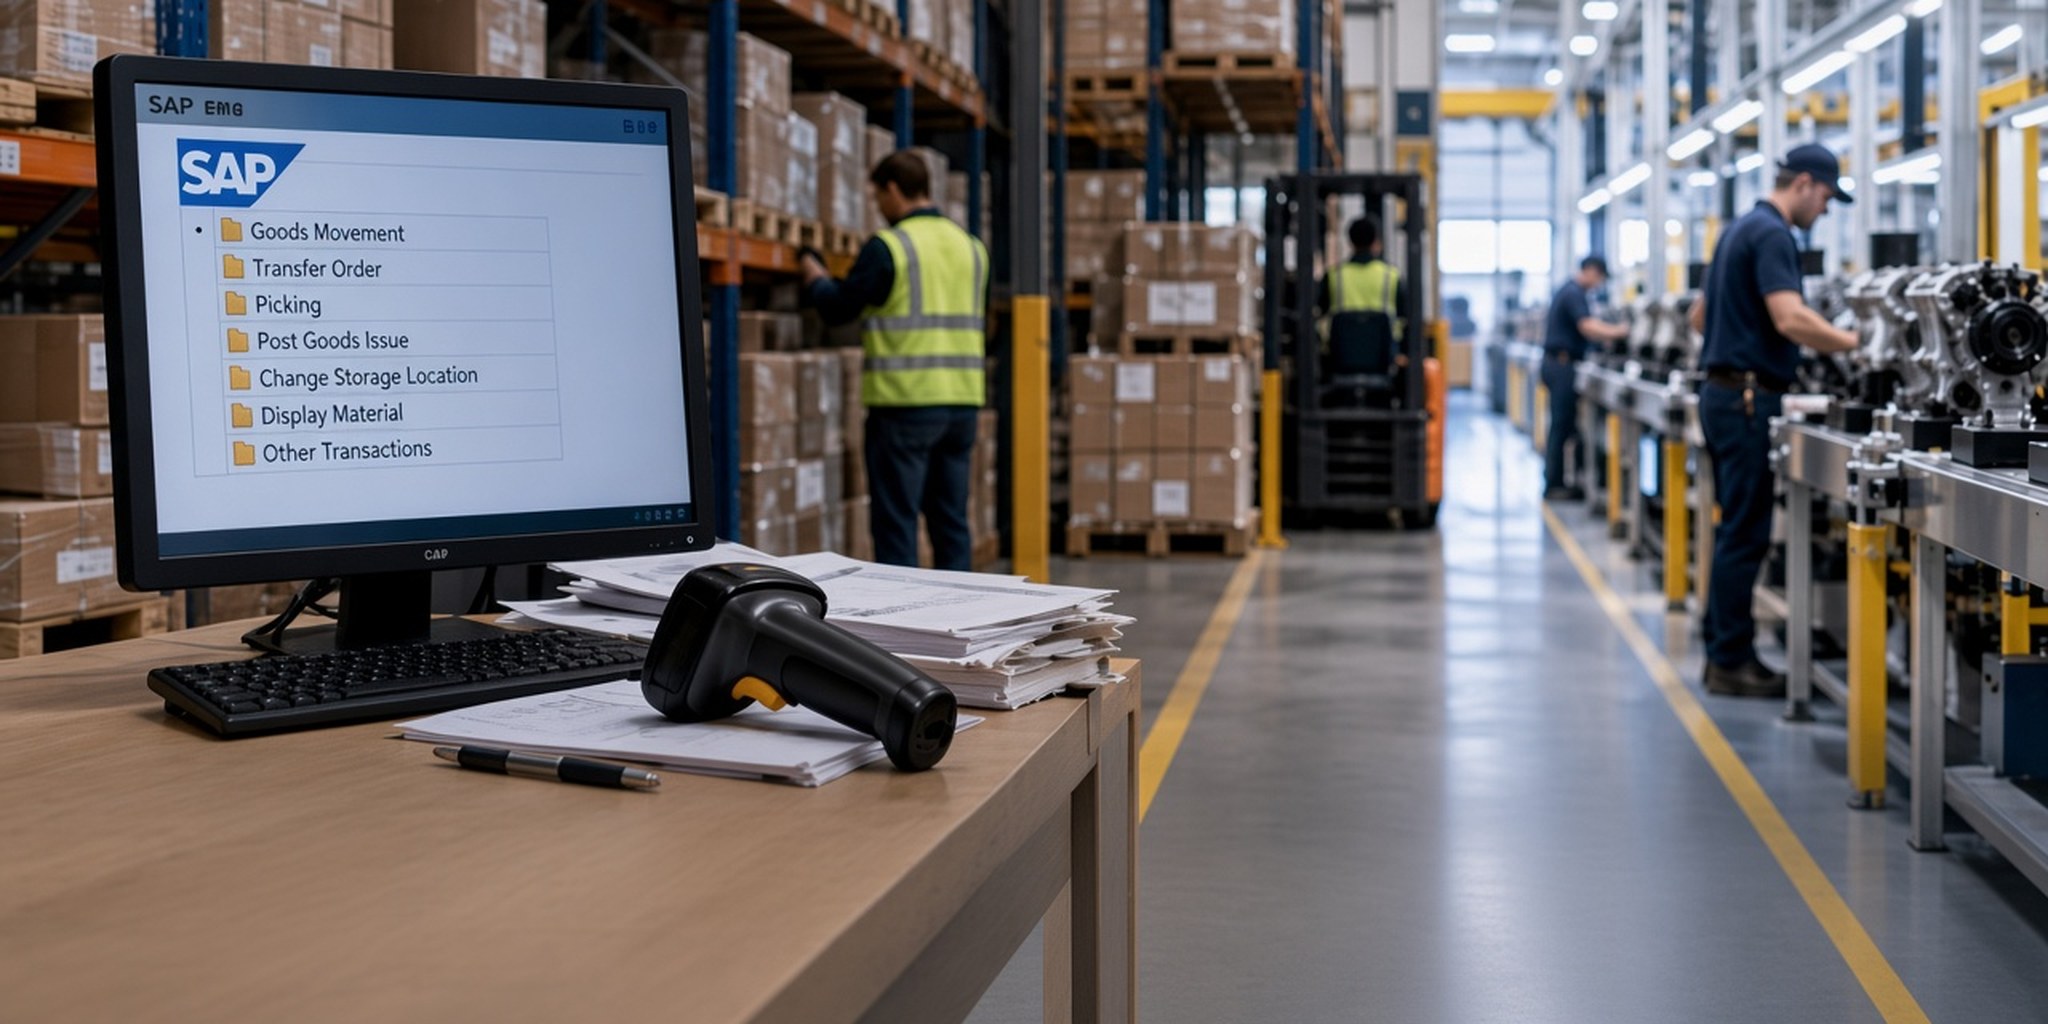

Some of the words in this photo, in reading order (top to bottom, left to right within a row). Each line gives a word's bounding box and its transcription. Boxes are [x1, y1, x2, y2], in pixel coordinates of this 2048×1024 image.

[148, 95, 193, 115] SAP
[181, 150, 276, 195] SAP
[250, 222, 308, 241] Goods
[314, 222, 405, 243] Movement
[253, 258, 326, 278] Transfer
[332, 259, 382, 278] Order
[255, 294, 322, 318] Picking
[257, 331, 298, 350] Post
[303, 330, 360, 350] Goods
[366, 330, 409, 350] Issue
[259, 368, 328, 391] Change
[334, 367, 401, 391] Storage
[407, 364, 478, 385] Location
[261, 404, 327, 429] Display
[333, 402, 403, 423] Material
[263, 442, 316, 463] Other
[321, 439, 432, 460] Transactions
